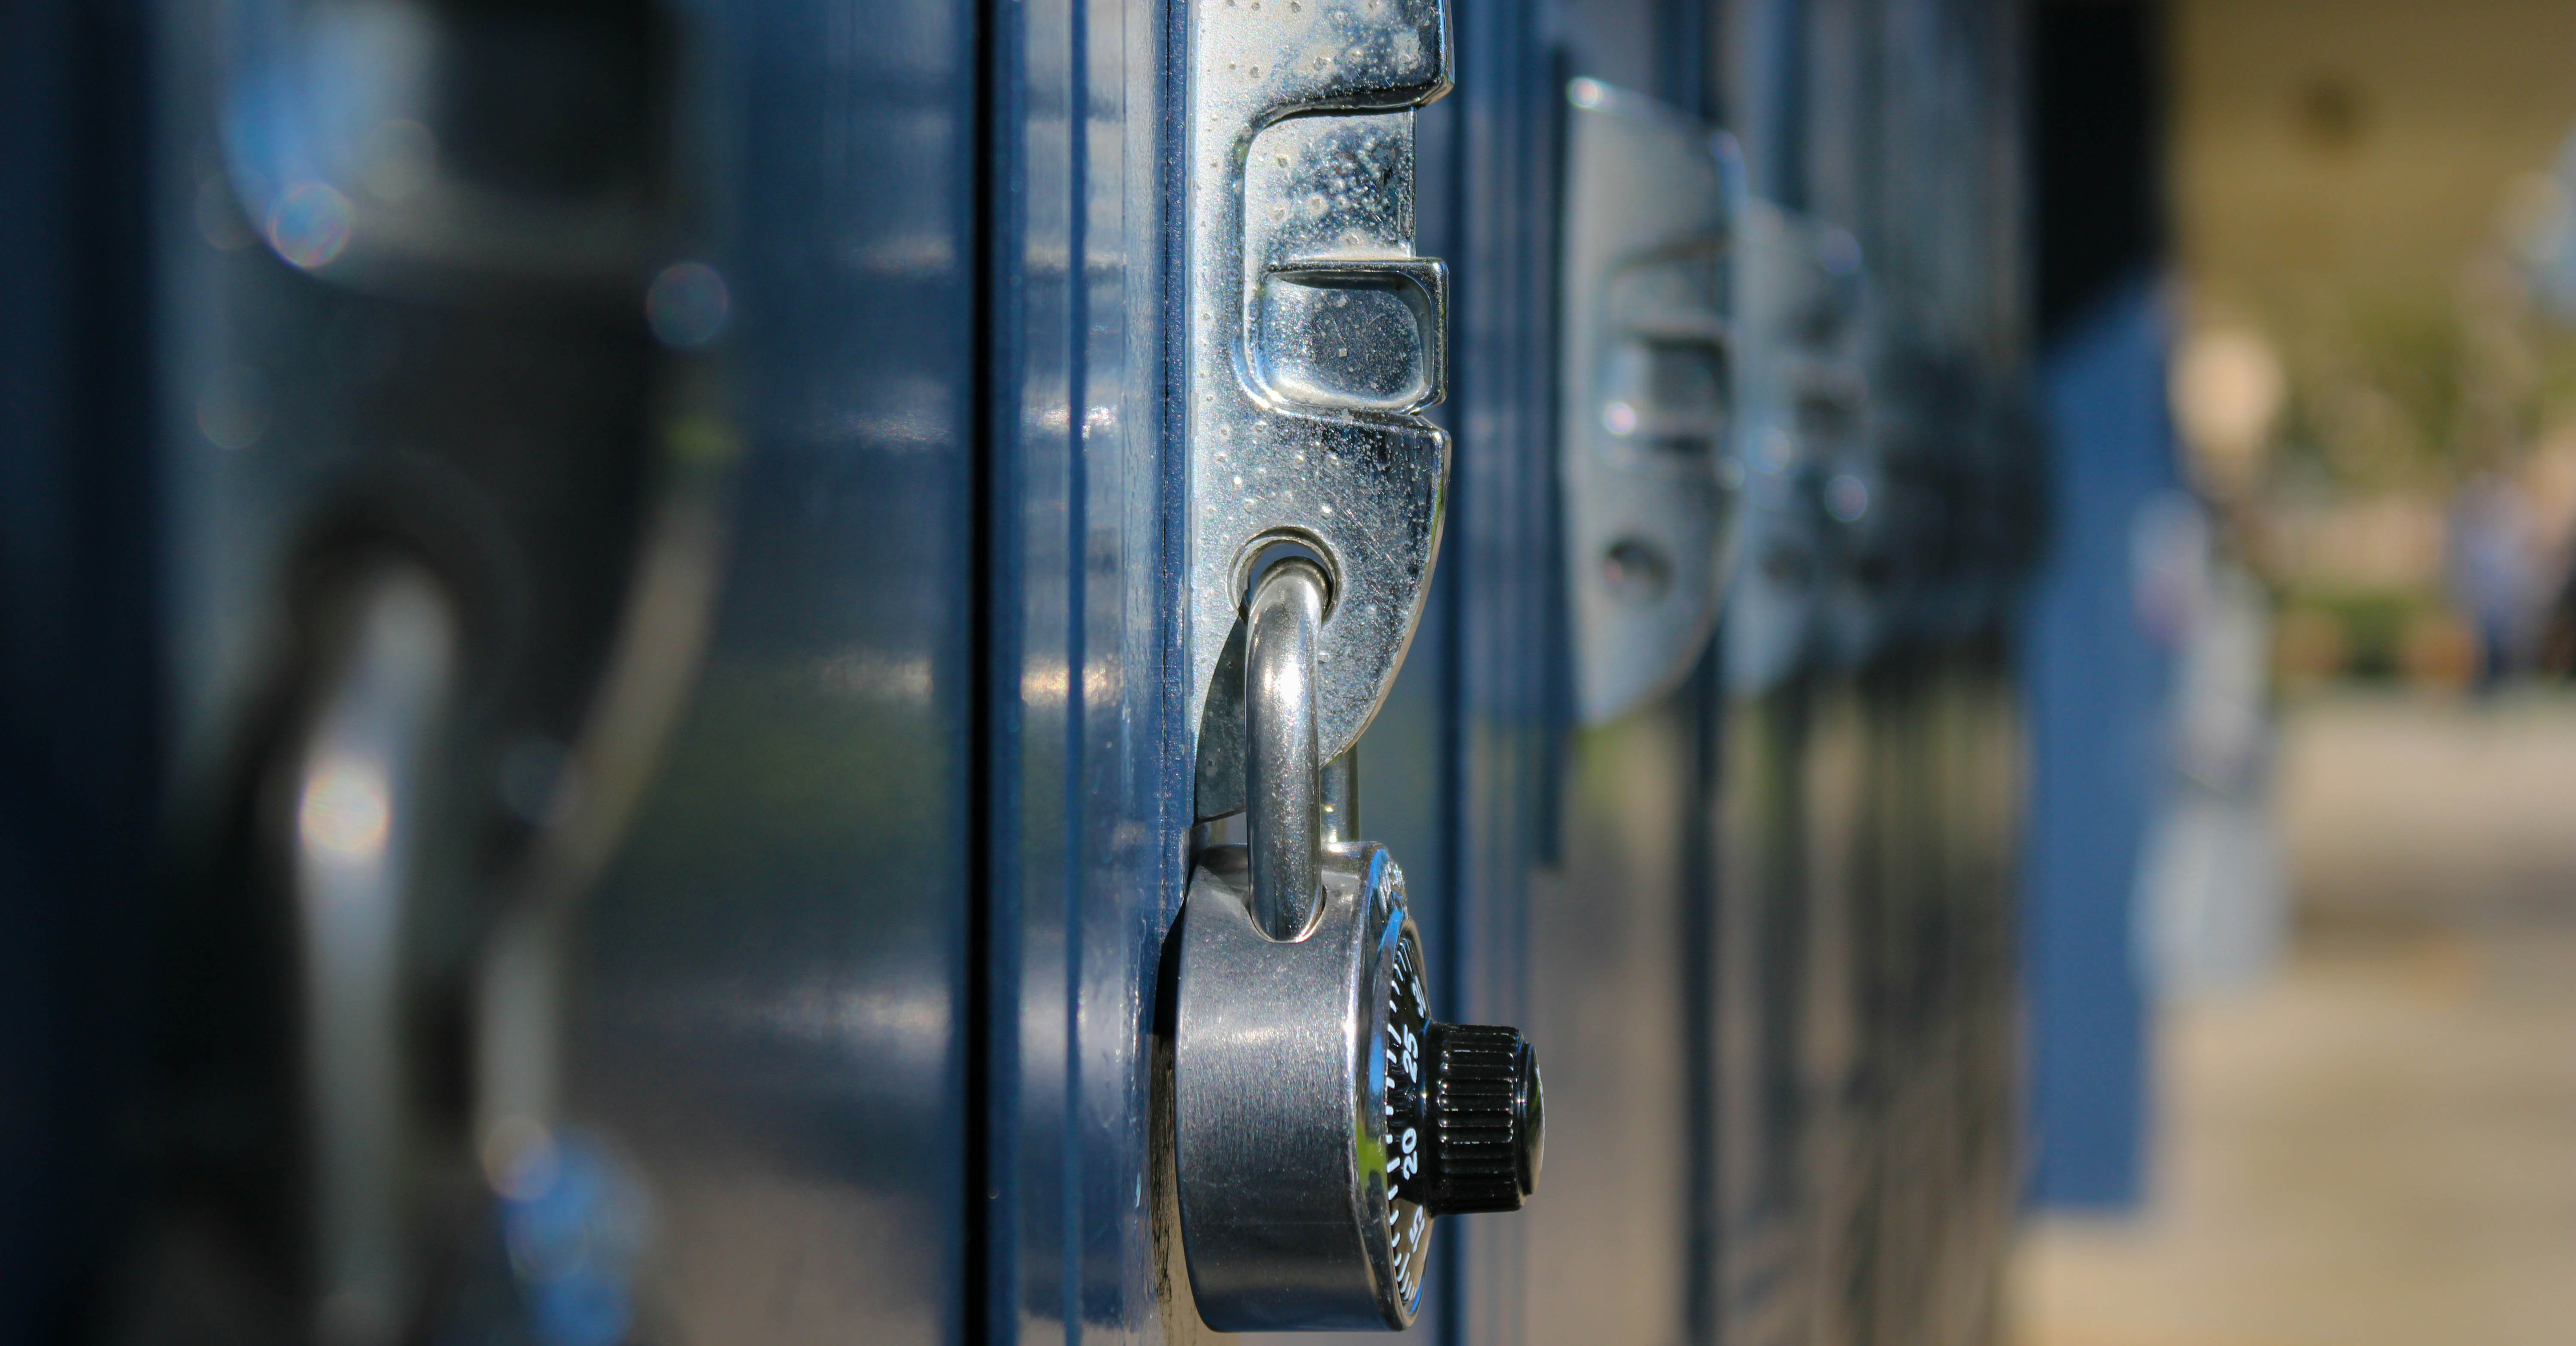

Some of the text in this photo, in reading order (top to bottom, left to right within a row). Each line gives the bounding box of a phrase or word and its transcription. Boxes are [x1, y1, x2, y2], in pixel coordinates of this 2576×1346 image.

[1403, 1024, 1418, 1084] 25
[1402, 1127, 1417, 1180] 20
[1410, 1205, 1425, 1254] 15
